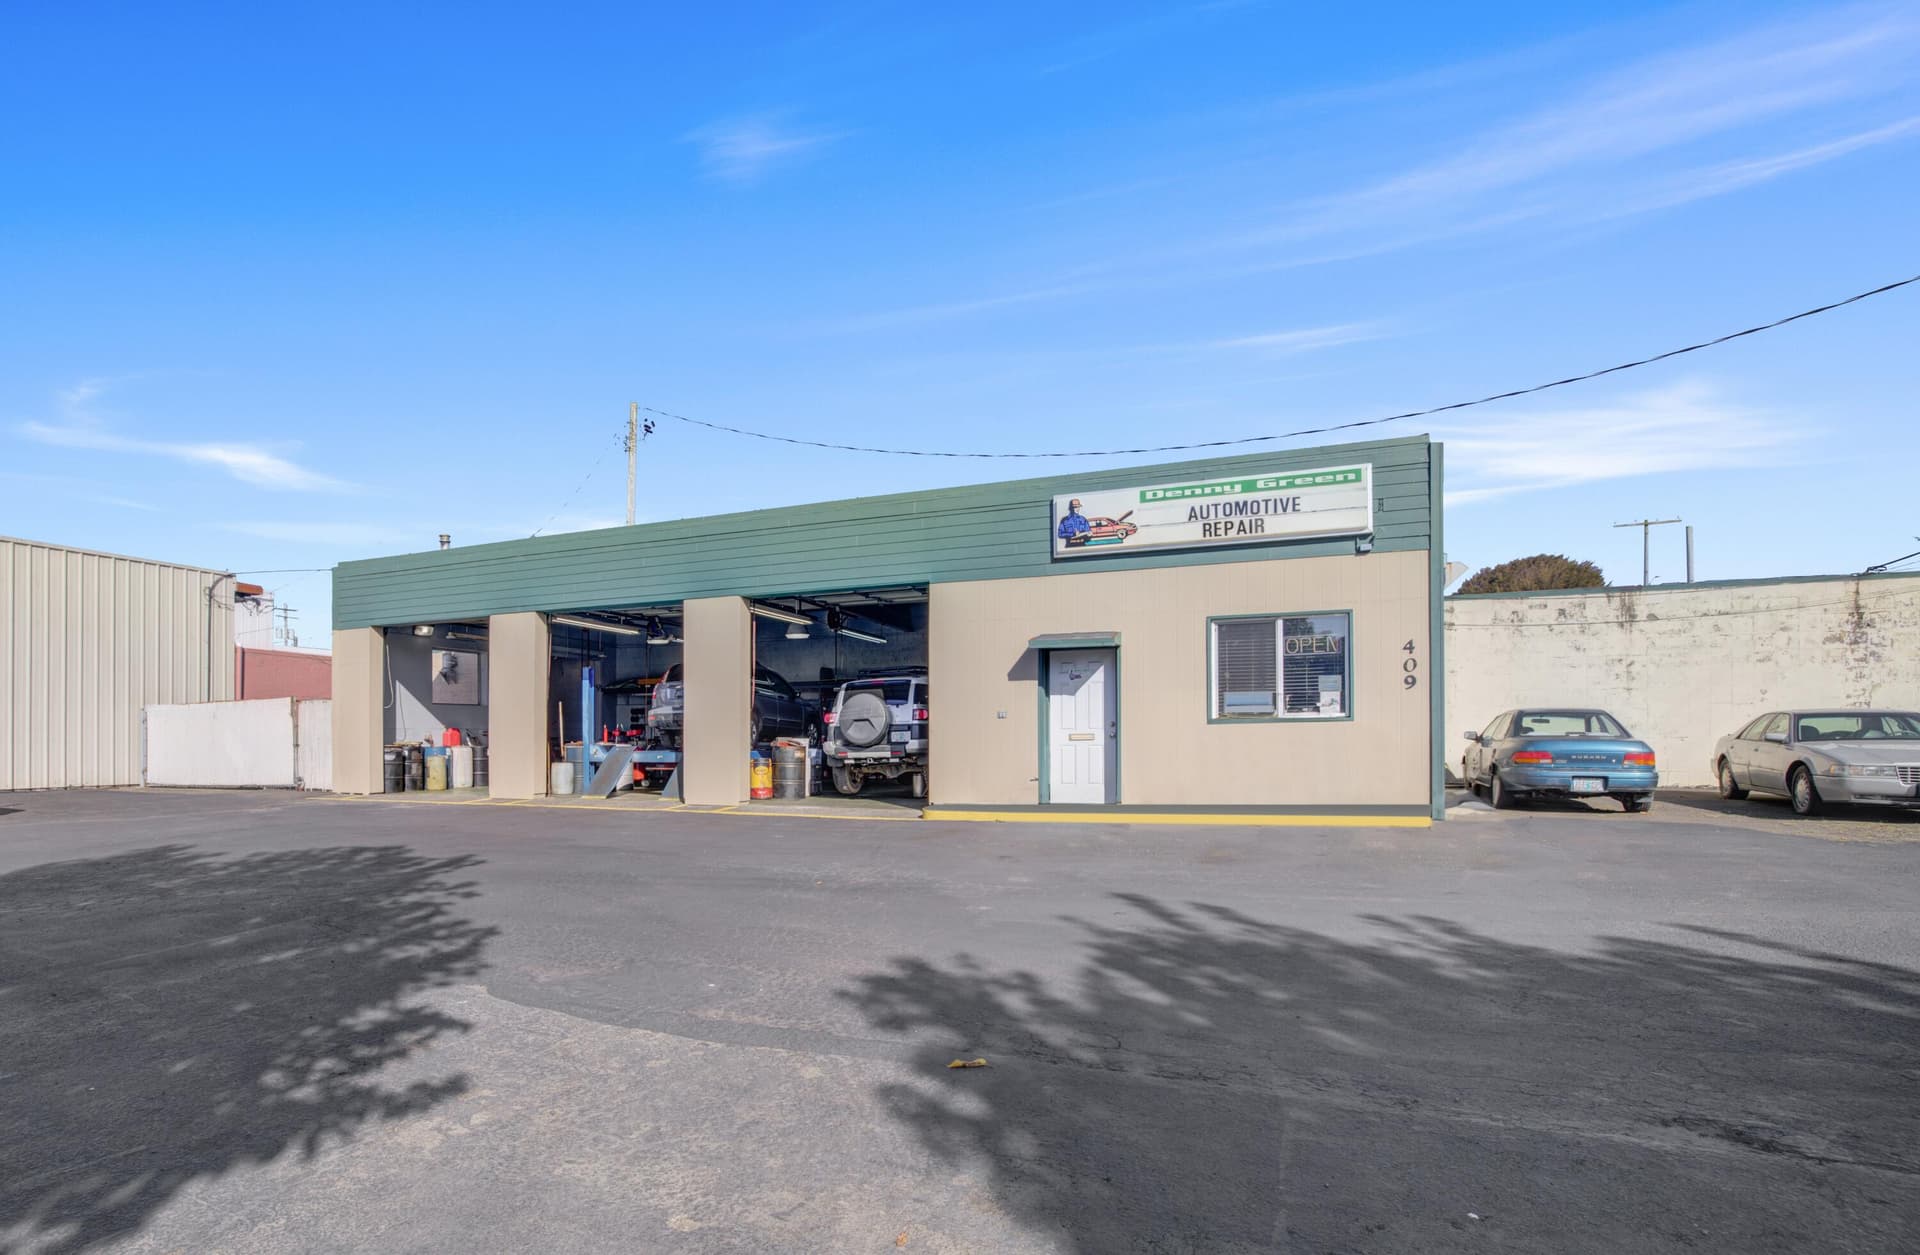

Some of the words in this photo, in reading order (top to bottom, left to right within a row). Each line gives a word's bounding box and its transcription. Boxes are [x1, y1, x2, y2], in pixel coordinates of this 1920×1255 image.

[1145, 483, 1242, 499] Denny
[1257, 473, 1356, 489] Green
[1188, 496, 1302, 522] AUTOMOTIVE
[1202, 518, 1265, 538] REPAIR
[1286, 636, 1340, 654] OPEN
[1403, 639, 1417, 690] 409
